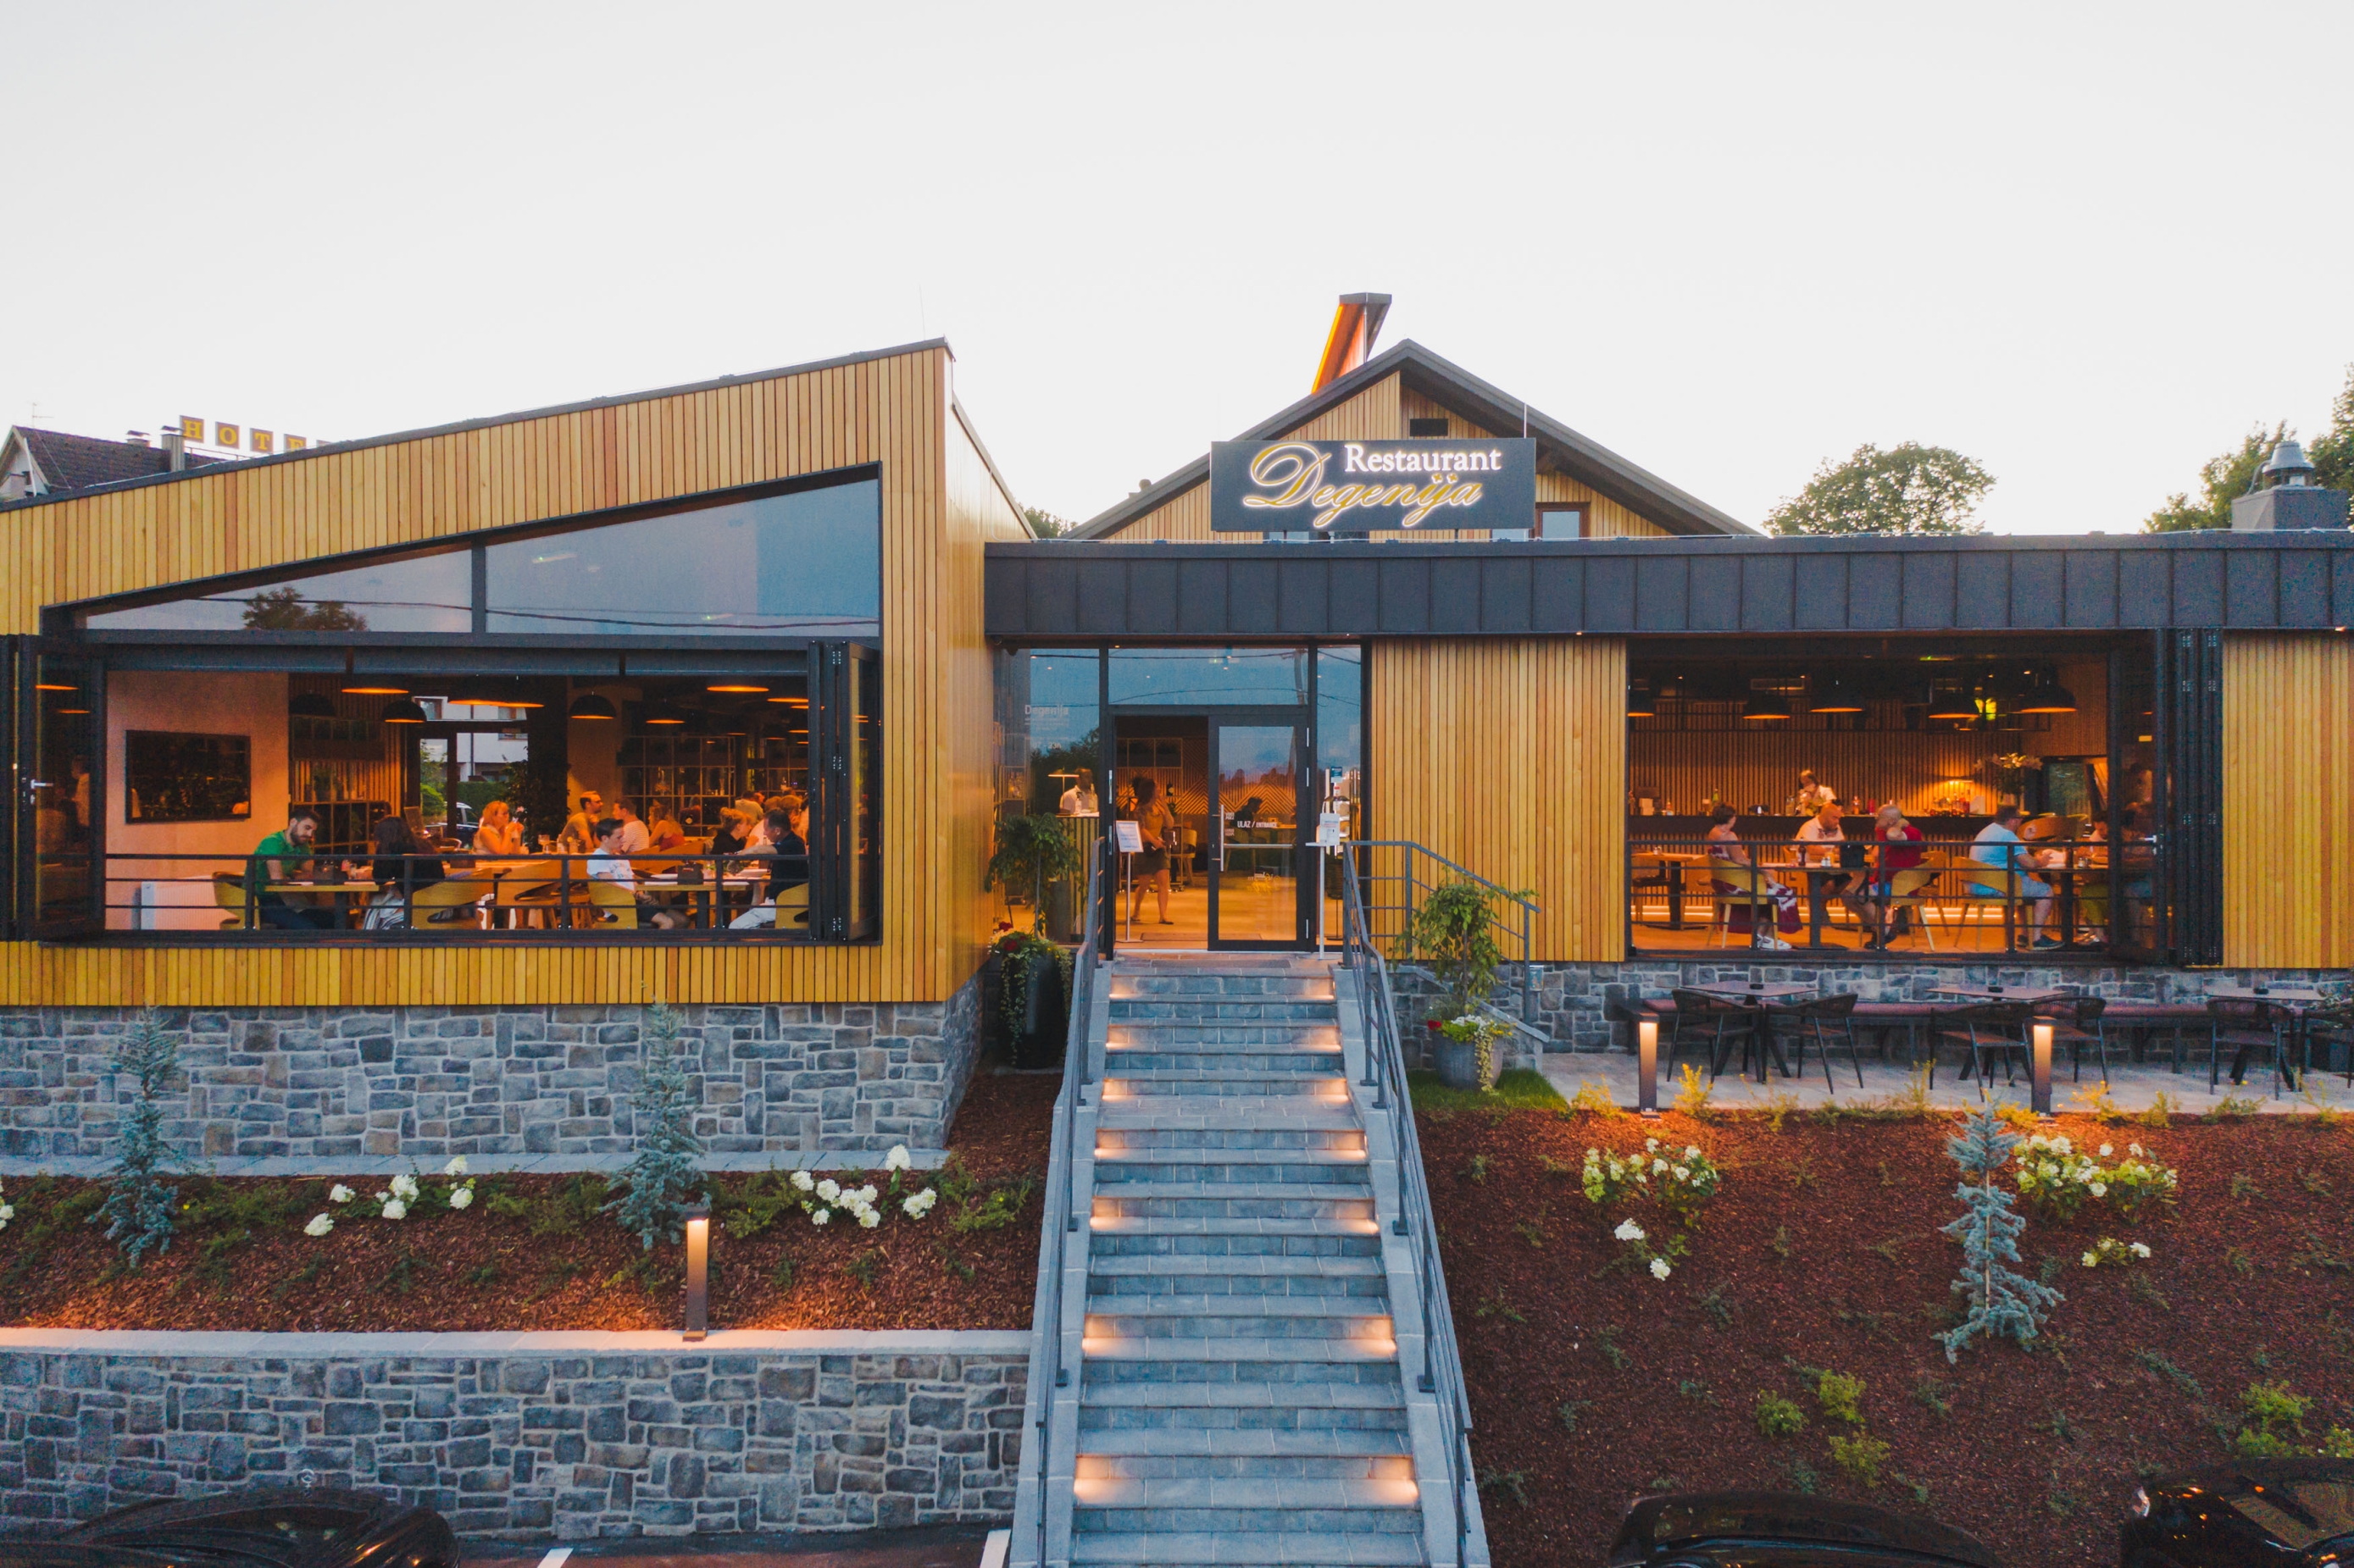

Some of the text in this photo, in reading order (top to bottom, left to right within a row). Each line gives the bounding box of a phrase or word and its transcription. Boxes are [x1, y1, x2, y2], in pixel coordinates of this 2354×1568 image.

[184, 419, 327, 452] HOTE
[1343, 443, 1502, 472] Restaurant
[1024, 704, 1069, 717] Degenija
[1237, 820, 1251, 828] ULAZ
